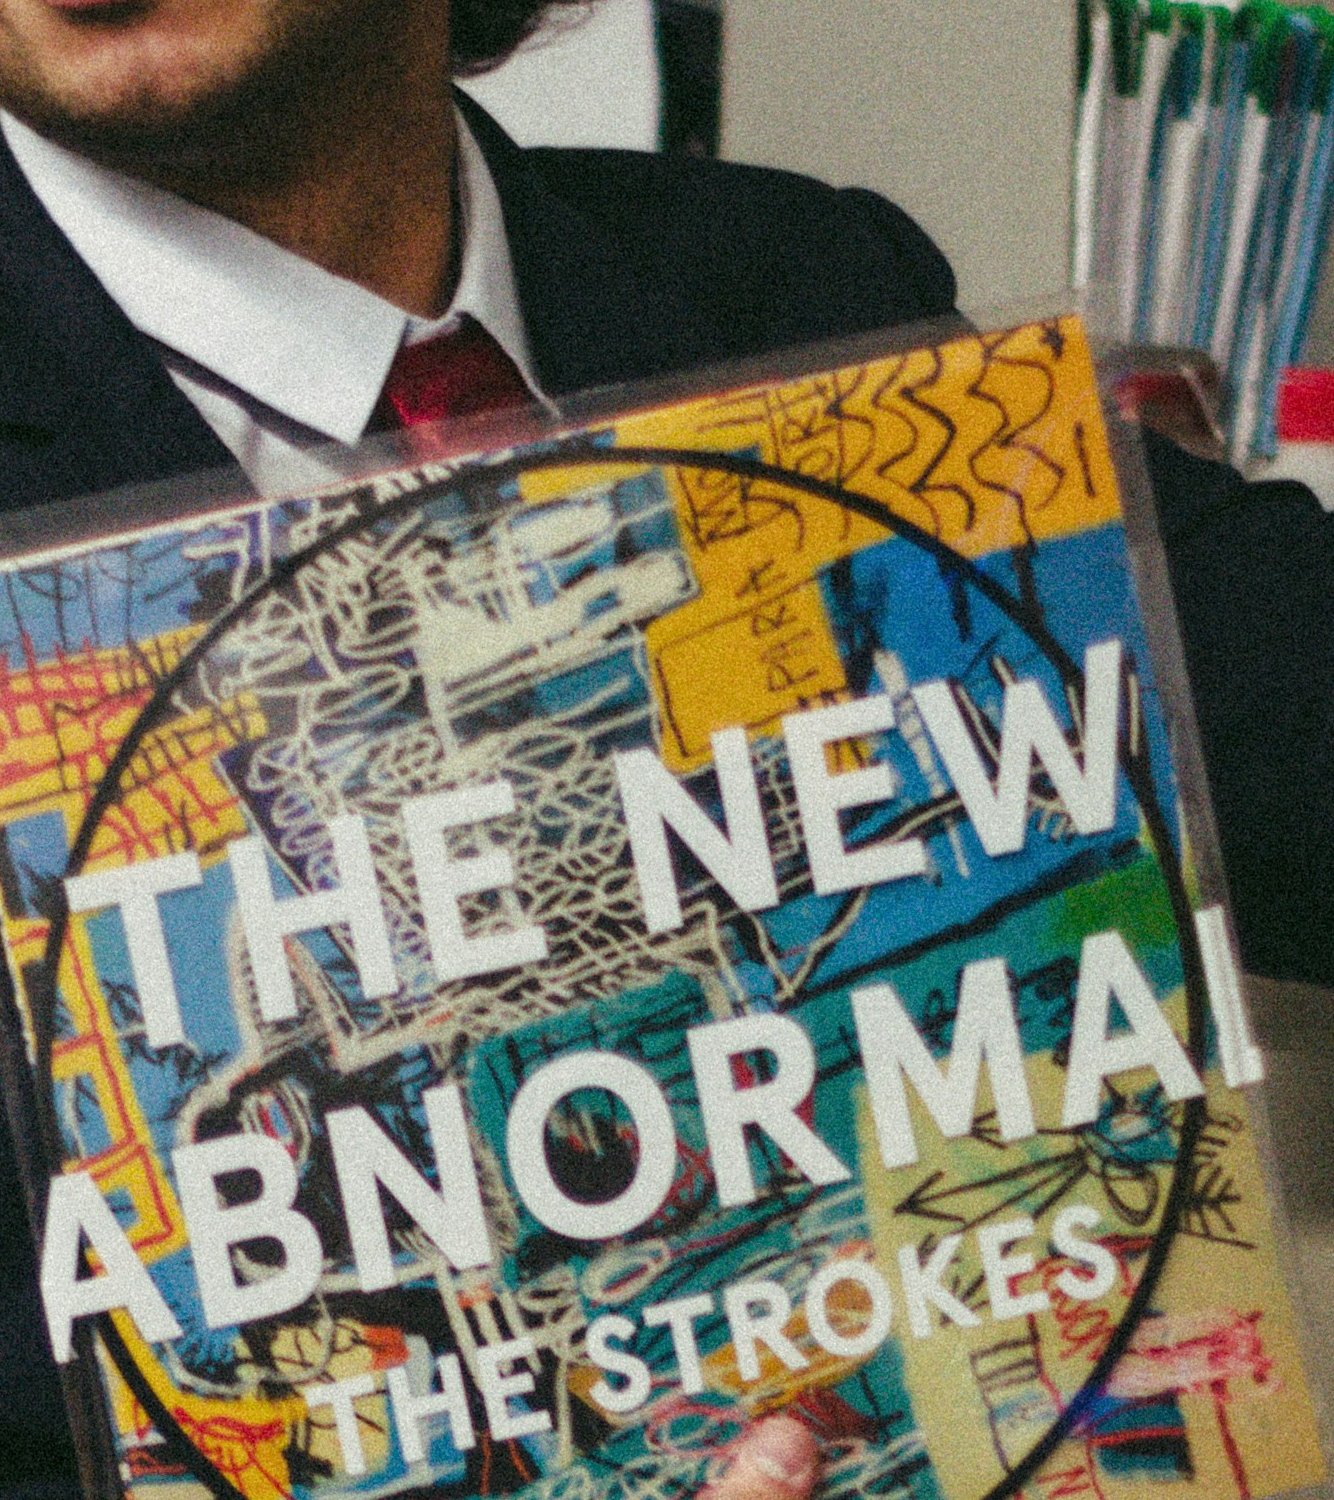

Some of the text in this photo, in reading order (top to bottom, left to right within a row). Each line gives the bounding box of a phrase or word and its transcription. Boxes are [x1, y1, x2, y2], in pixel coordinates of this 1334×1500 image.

[63, 635, 1130, 1050] THE NEW
[37, 904, 1266, 1364] ABNORMAL
[306, 1336, 553, 1478] THE
[587, 1202, 1119, 1414] STROKES
